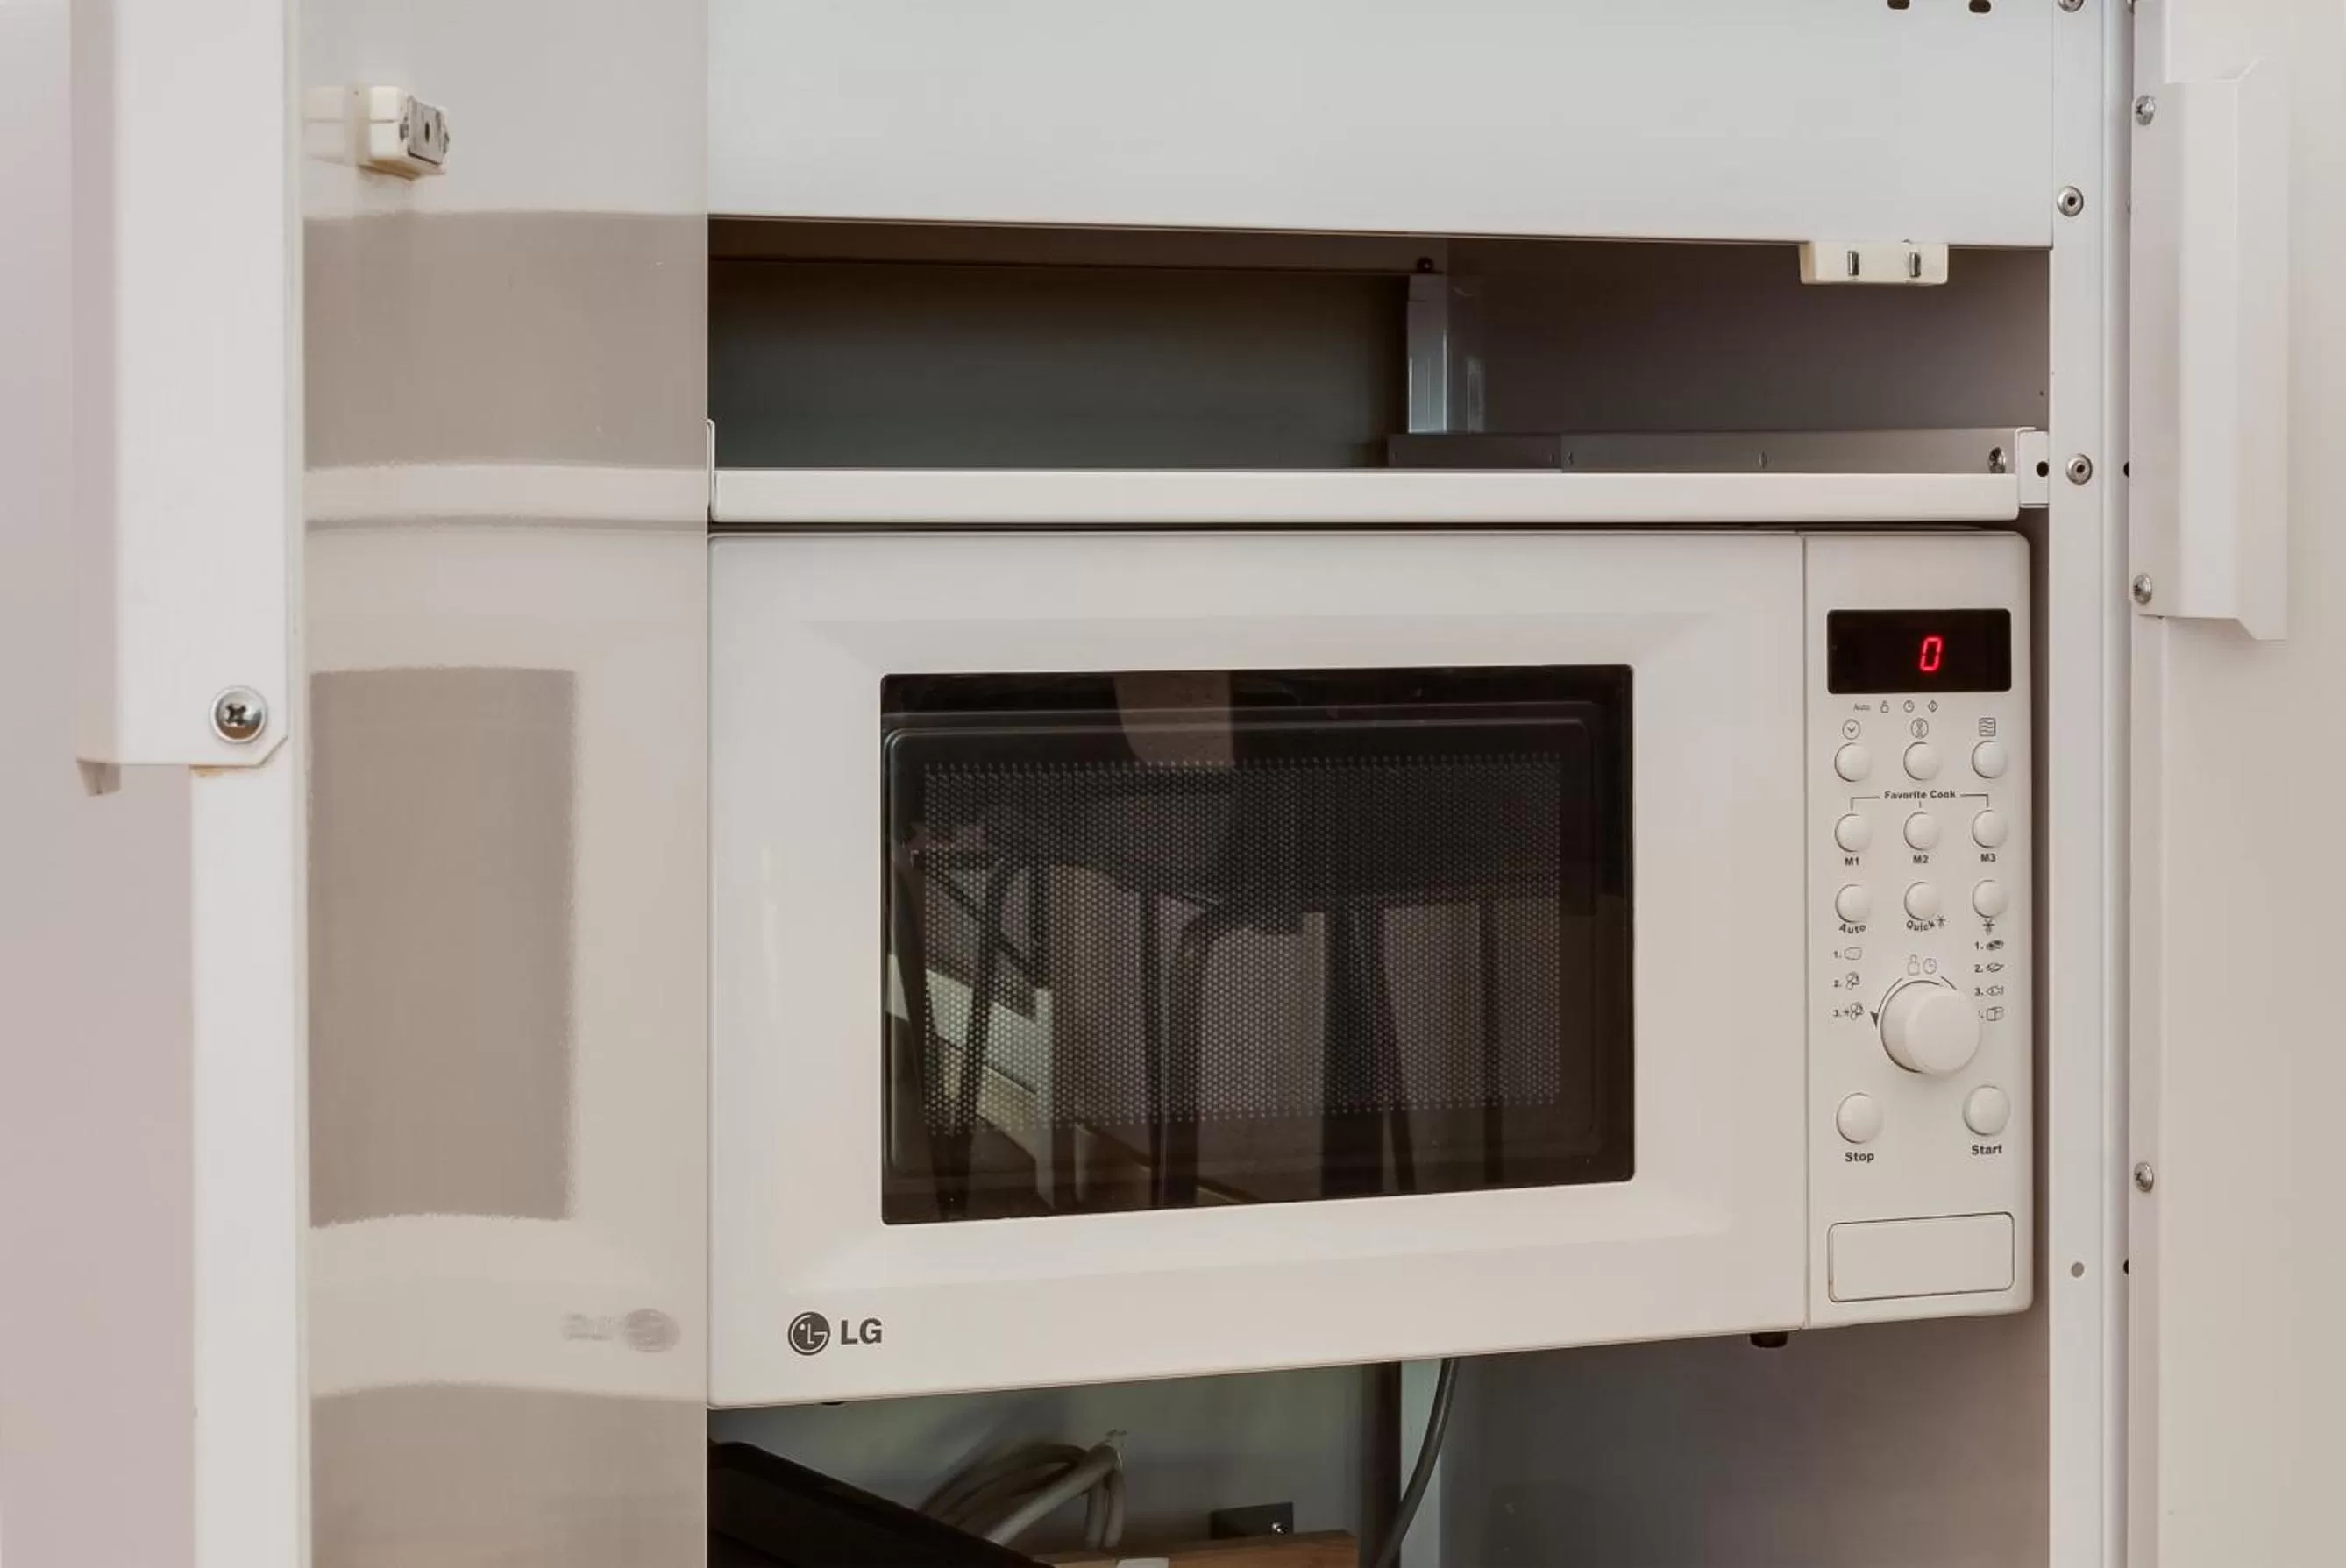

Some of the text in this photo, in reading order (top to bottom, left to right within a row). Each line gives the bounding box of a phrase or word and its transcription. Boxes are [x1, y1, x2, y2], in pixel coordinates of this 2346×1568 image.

[1919, 636, 1944, 672] 0
[1884, 789, 1957, 800] Favorite Cook
[1845, 857, 1860, 866] M1
[1913, 855, 1930, 864] M2
[1980, 854, 1997, 862] M3
[1838, 923, 1867, 934] Auto
[1906, 919, 1937, 933] Quick
[1971, 1143, 2003, 1155] Start
[1844, 1151, 1875, 1163] Stop
[840, 1317, 884, 1345] LG
